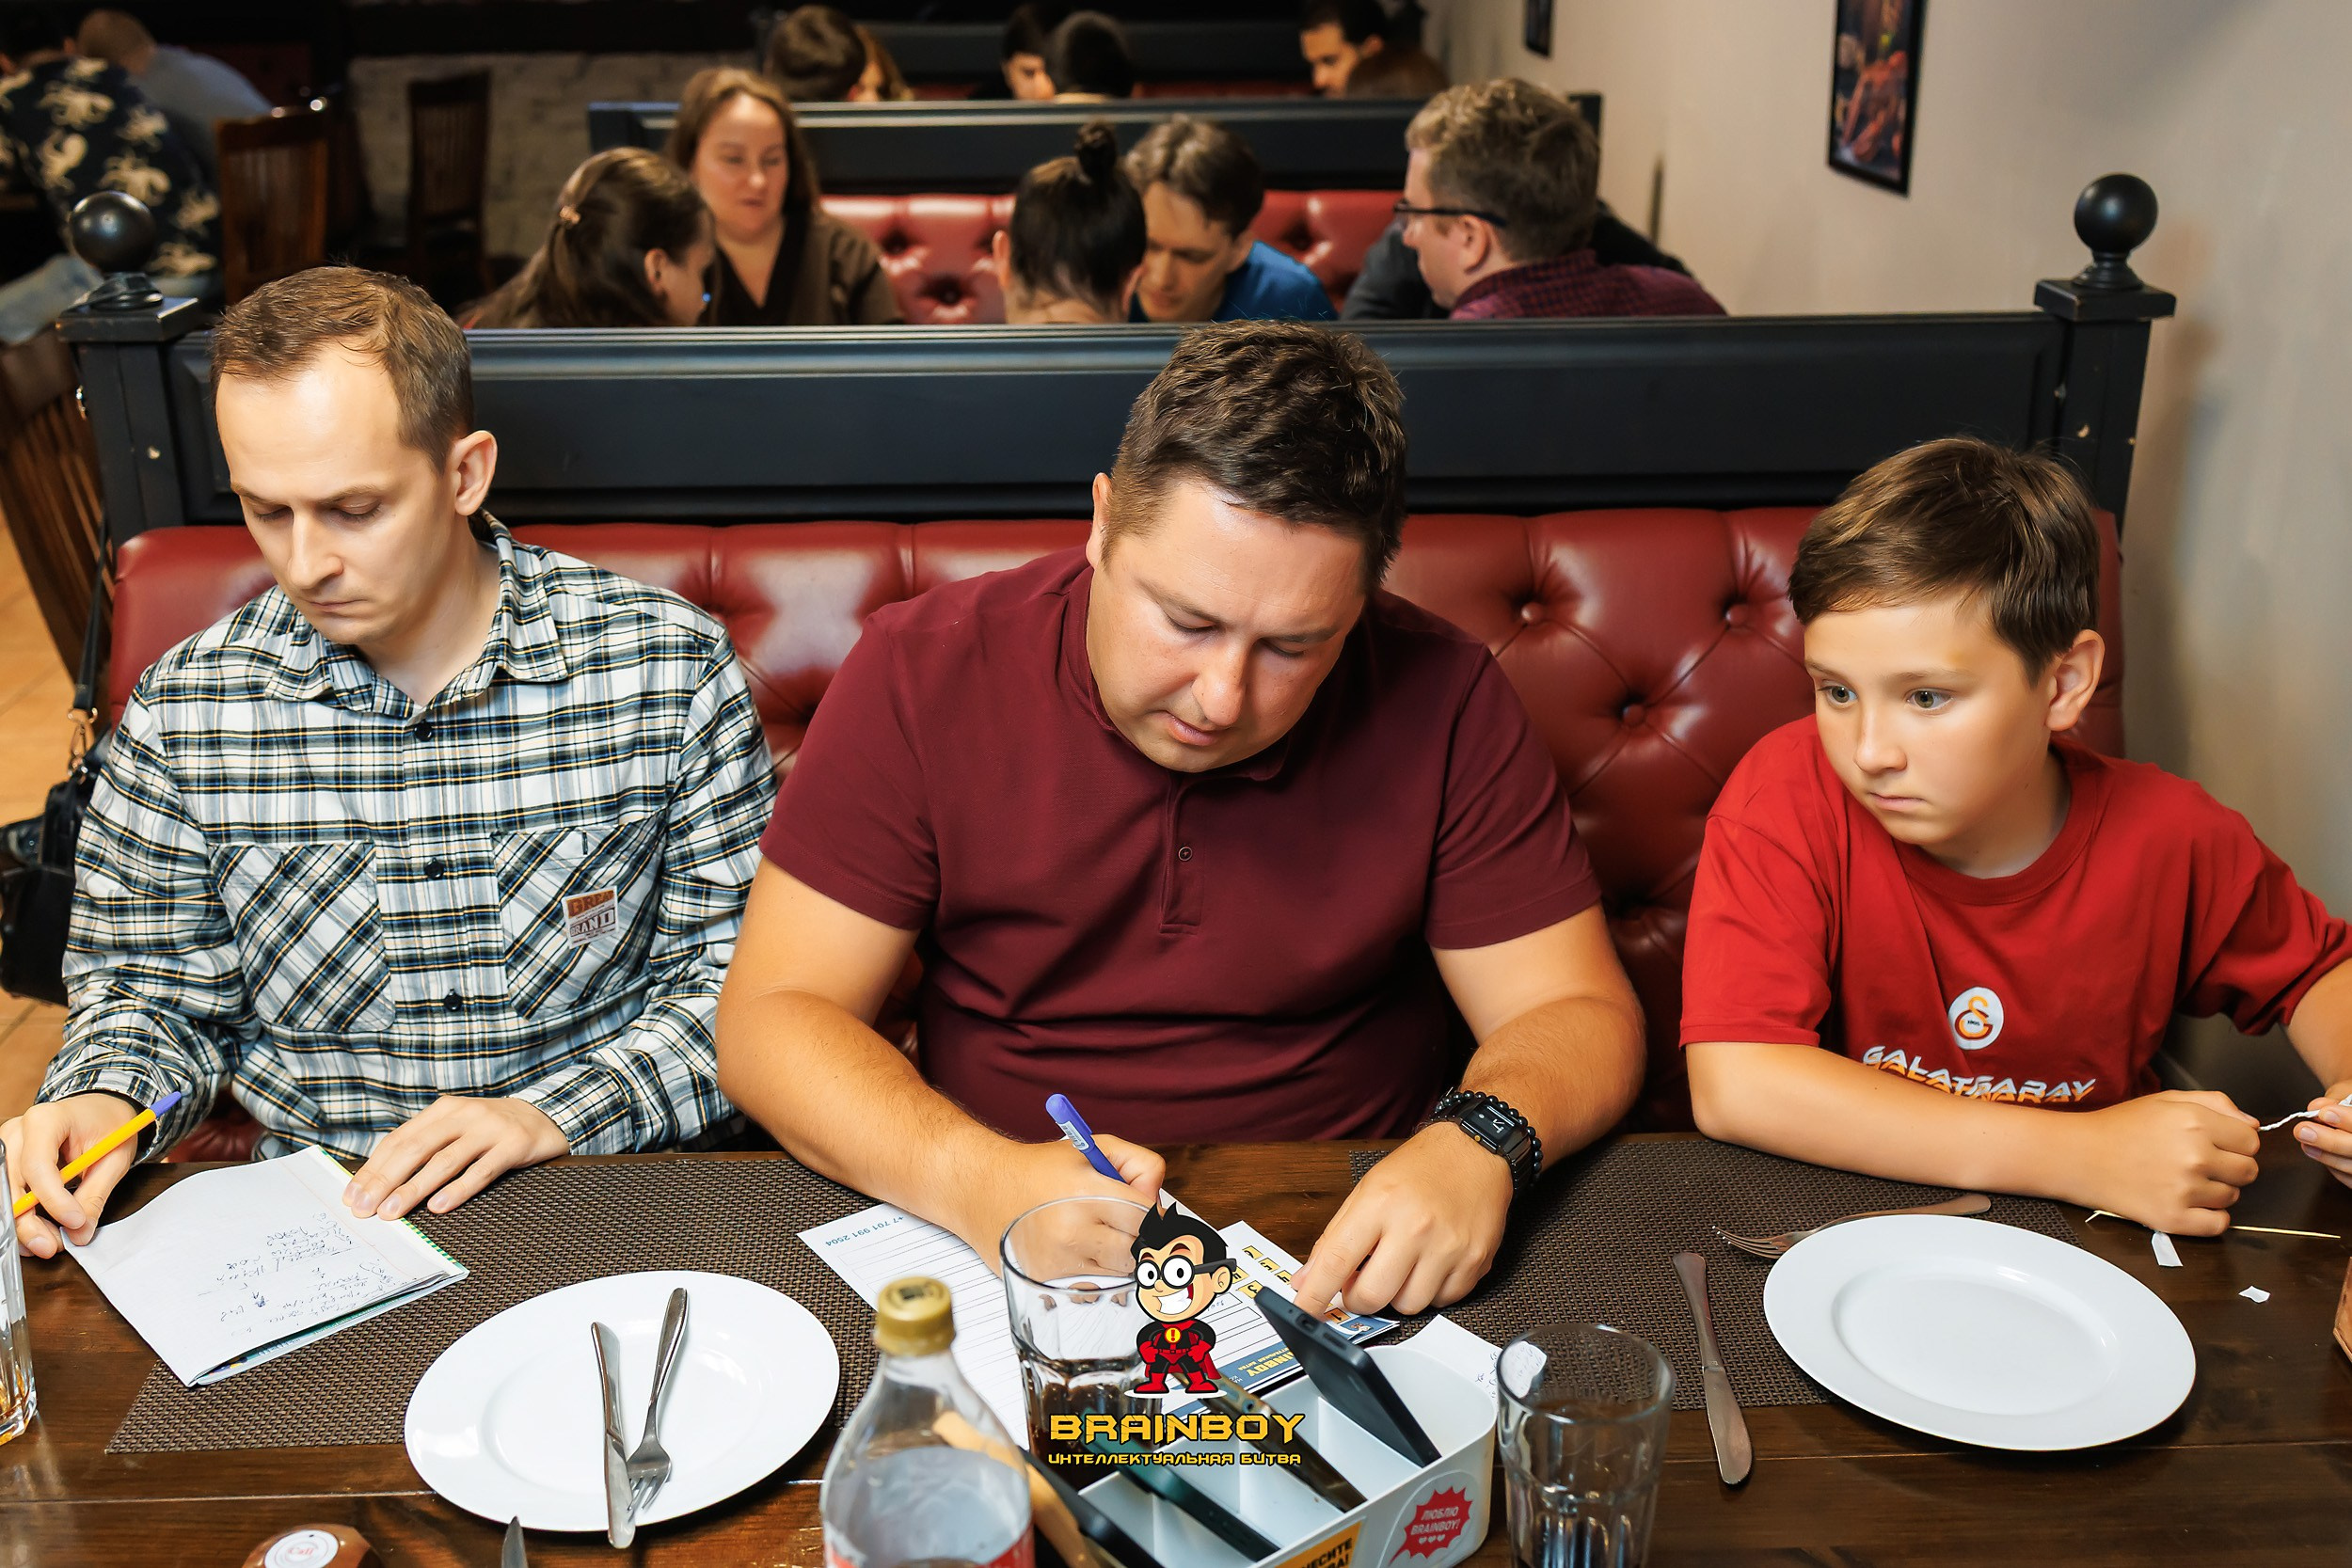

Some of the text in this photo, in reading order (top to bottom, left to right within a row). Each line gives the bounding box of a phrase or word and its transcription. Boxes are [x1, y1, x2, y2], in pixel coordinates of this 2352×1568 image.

[570, 909, 614, 937] BRAND
[872, 1221, 891, 1231] 701
[851, 1227, 871, 1238] 991
[825, 1235, 850, 1246] 2504
[1422, 1506, 1459, 1520] ЛЮБЛЮ
[1411, 1518, 1460, 1535] BRAINBOY!
